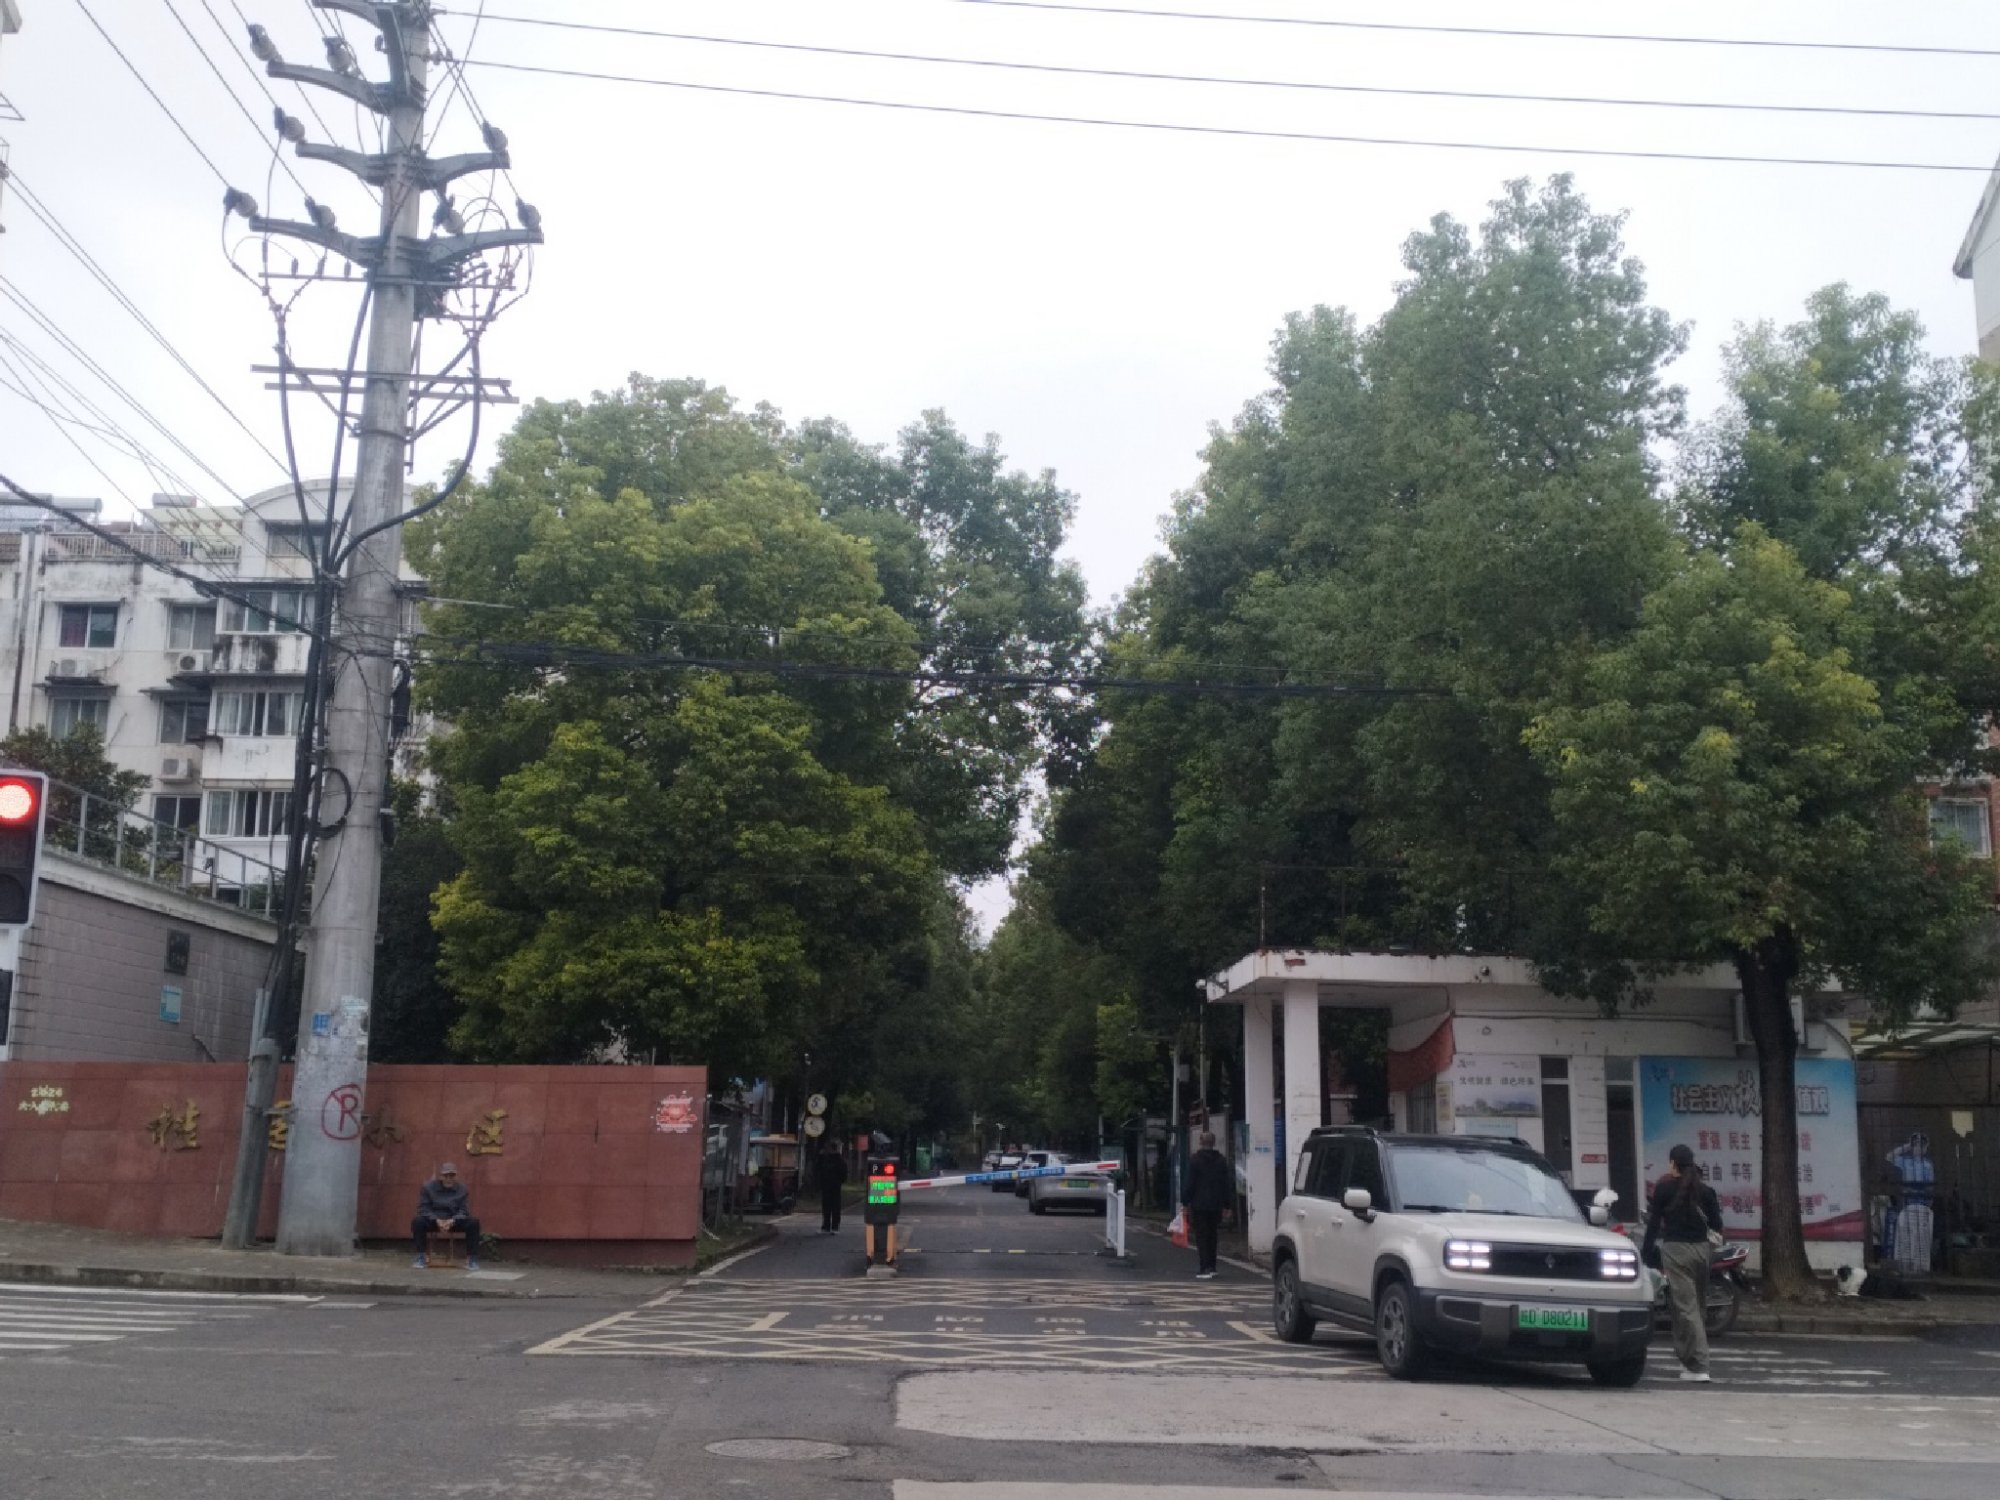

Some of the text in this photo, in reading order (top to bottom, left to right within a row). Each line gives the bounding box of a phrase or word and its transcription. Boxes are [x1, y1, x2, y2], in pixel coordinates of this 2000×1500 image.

[1672, 1070, 1830, 1117] 社会主义核值观
[1698, 1129, 1721, 1151] 富强
[1728, 1130, 1752, 1151] 民主
[1701, 1160, 1723, 1181] 自由
[1731, 1162, 1753, 1182] 平等
